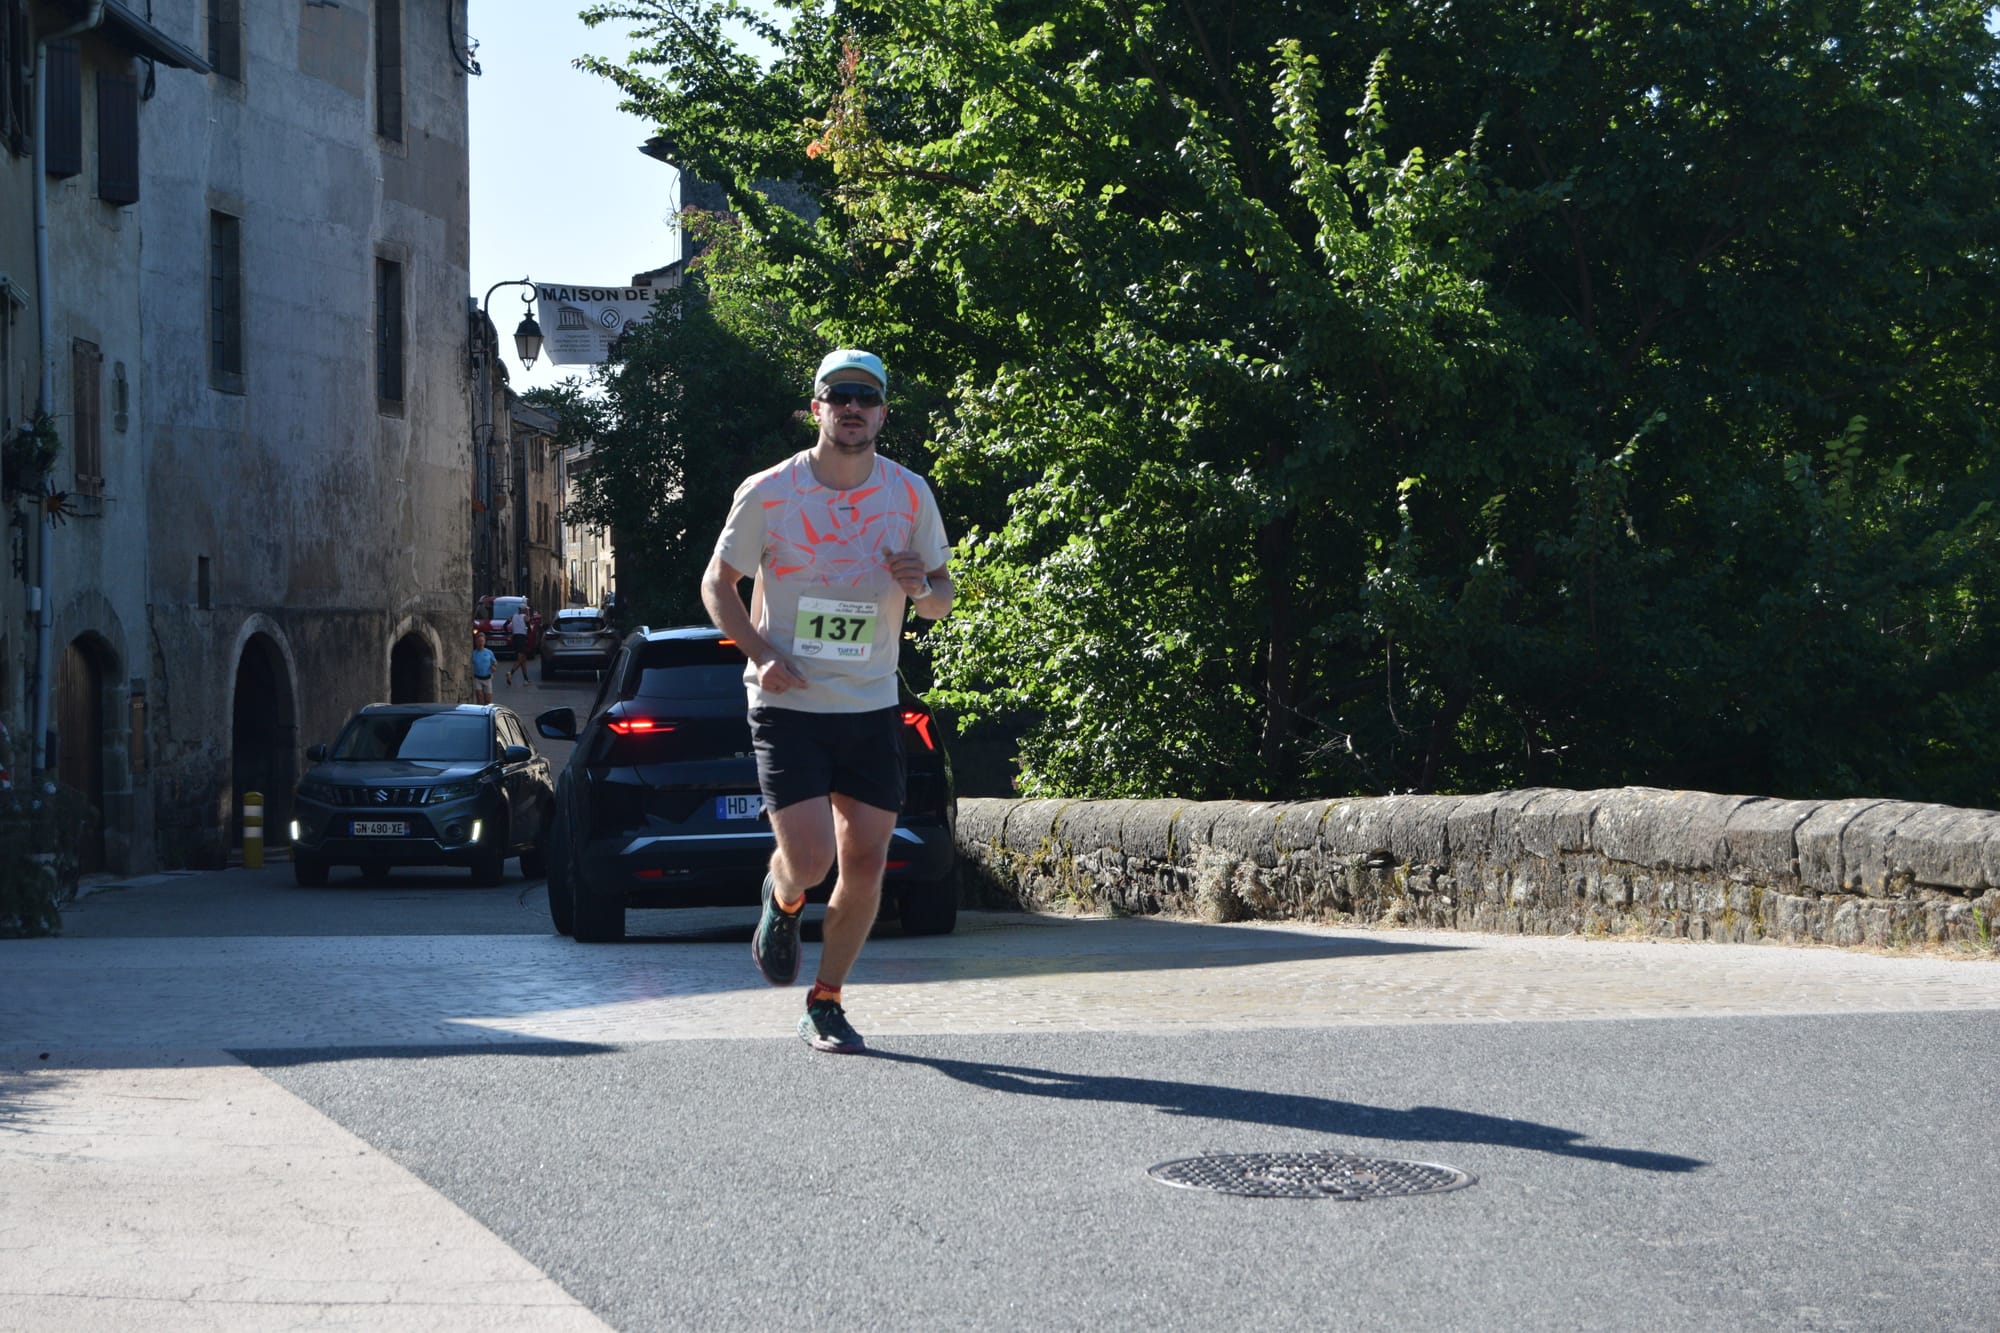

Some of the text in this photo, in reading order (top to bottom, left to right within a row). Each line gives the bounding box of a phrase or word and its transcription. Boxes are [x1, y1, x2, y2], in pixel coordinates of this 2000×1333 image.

[543, 288, 619, 302] MAISON
[625, 289, 649, 300] DE
[809, 616, 866, 641] 137
